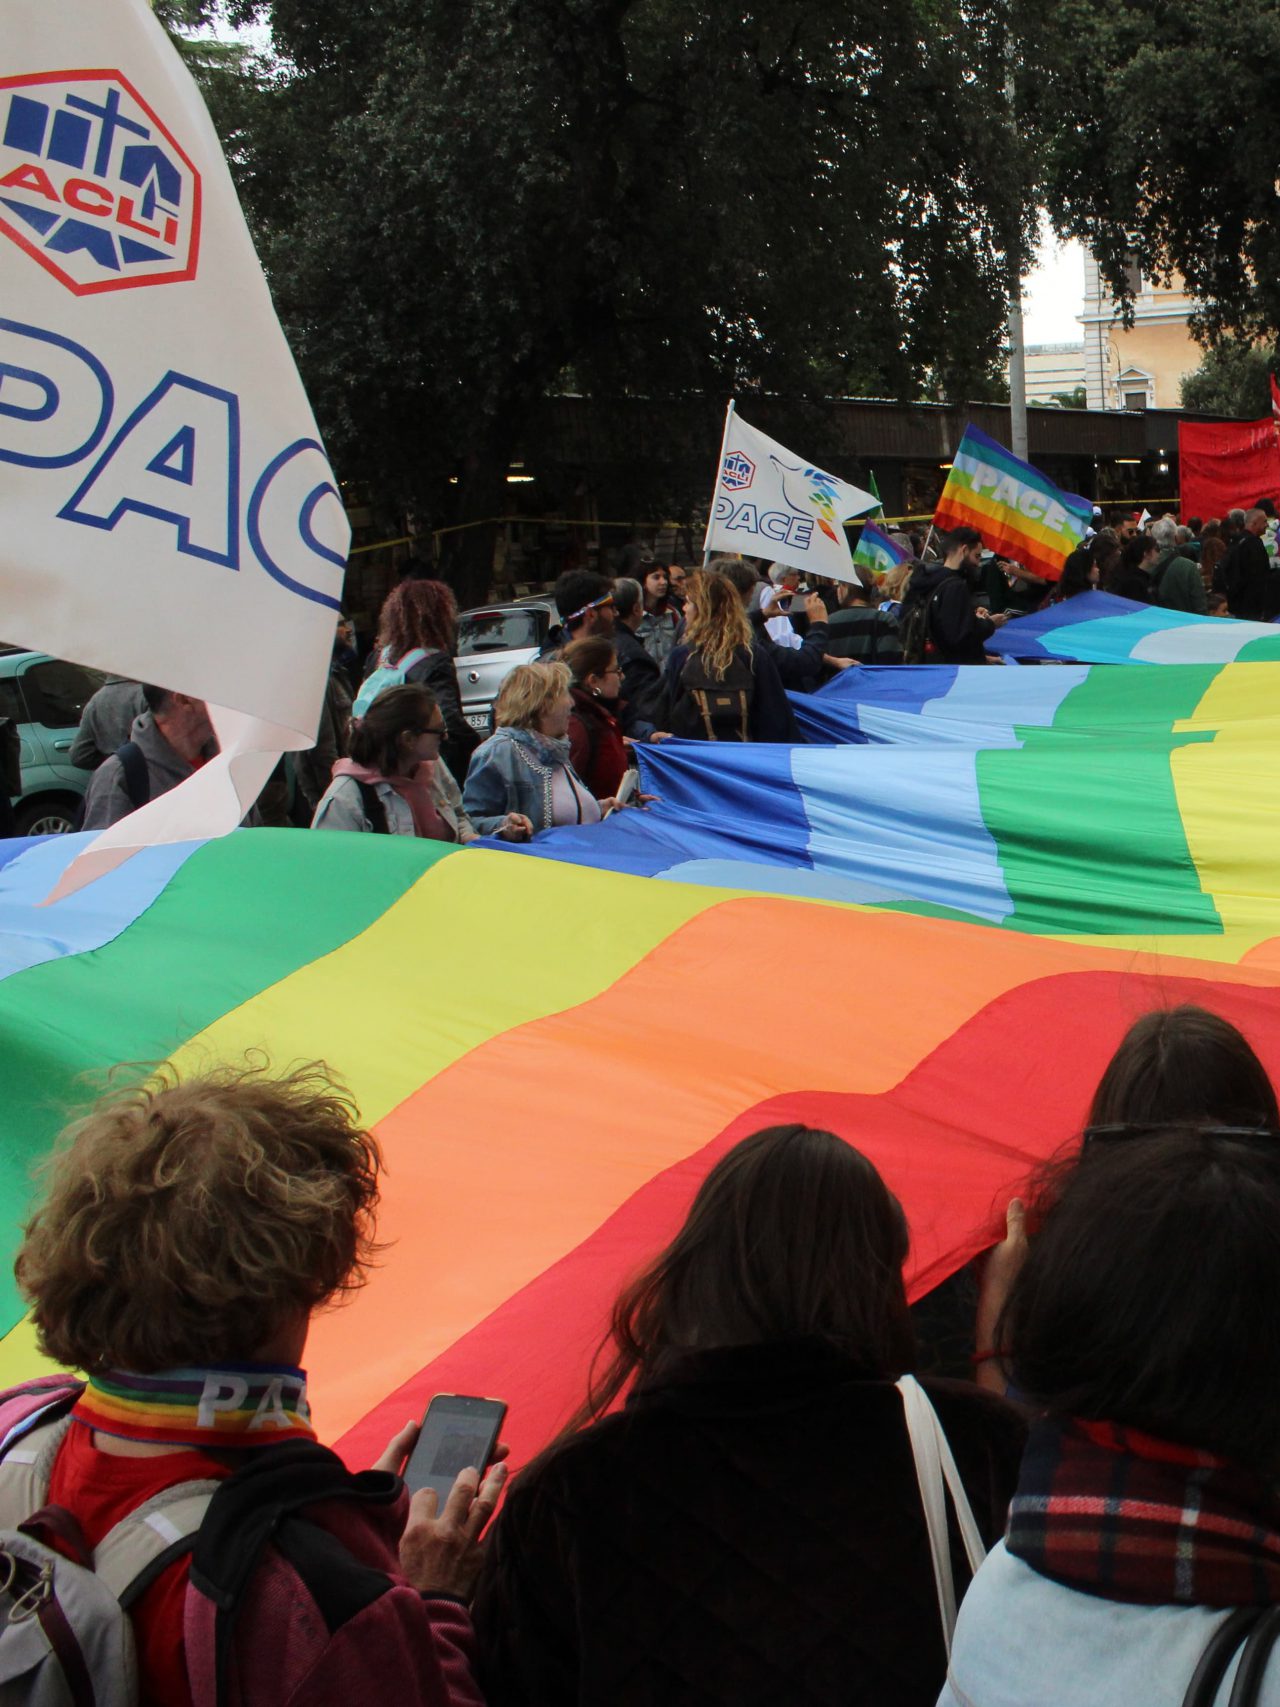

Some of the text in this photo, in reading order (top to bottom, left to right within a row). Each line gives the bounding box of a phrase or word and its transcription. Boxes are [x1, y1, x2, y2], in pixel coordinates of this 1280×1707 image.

[0, 162, 179, 246] ACLI
[716, 496, 814, 551] PACE
[970, 462, 1069, 532] PACE
